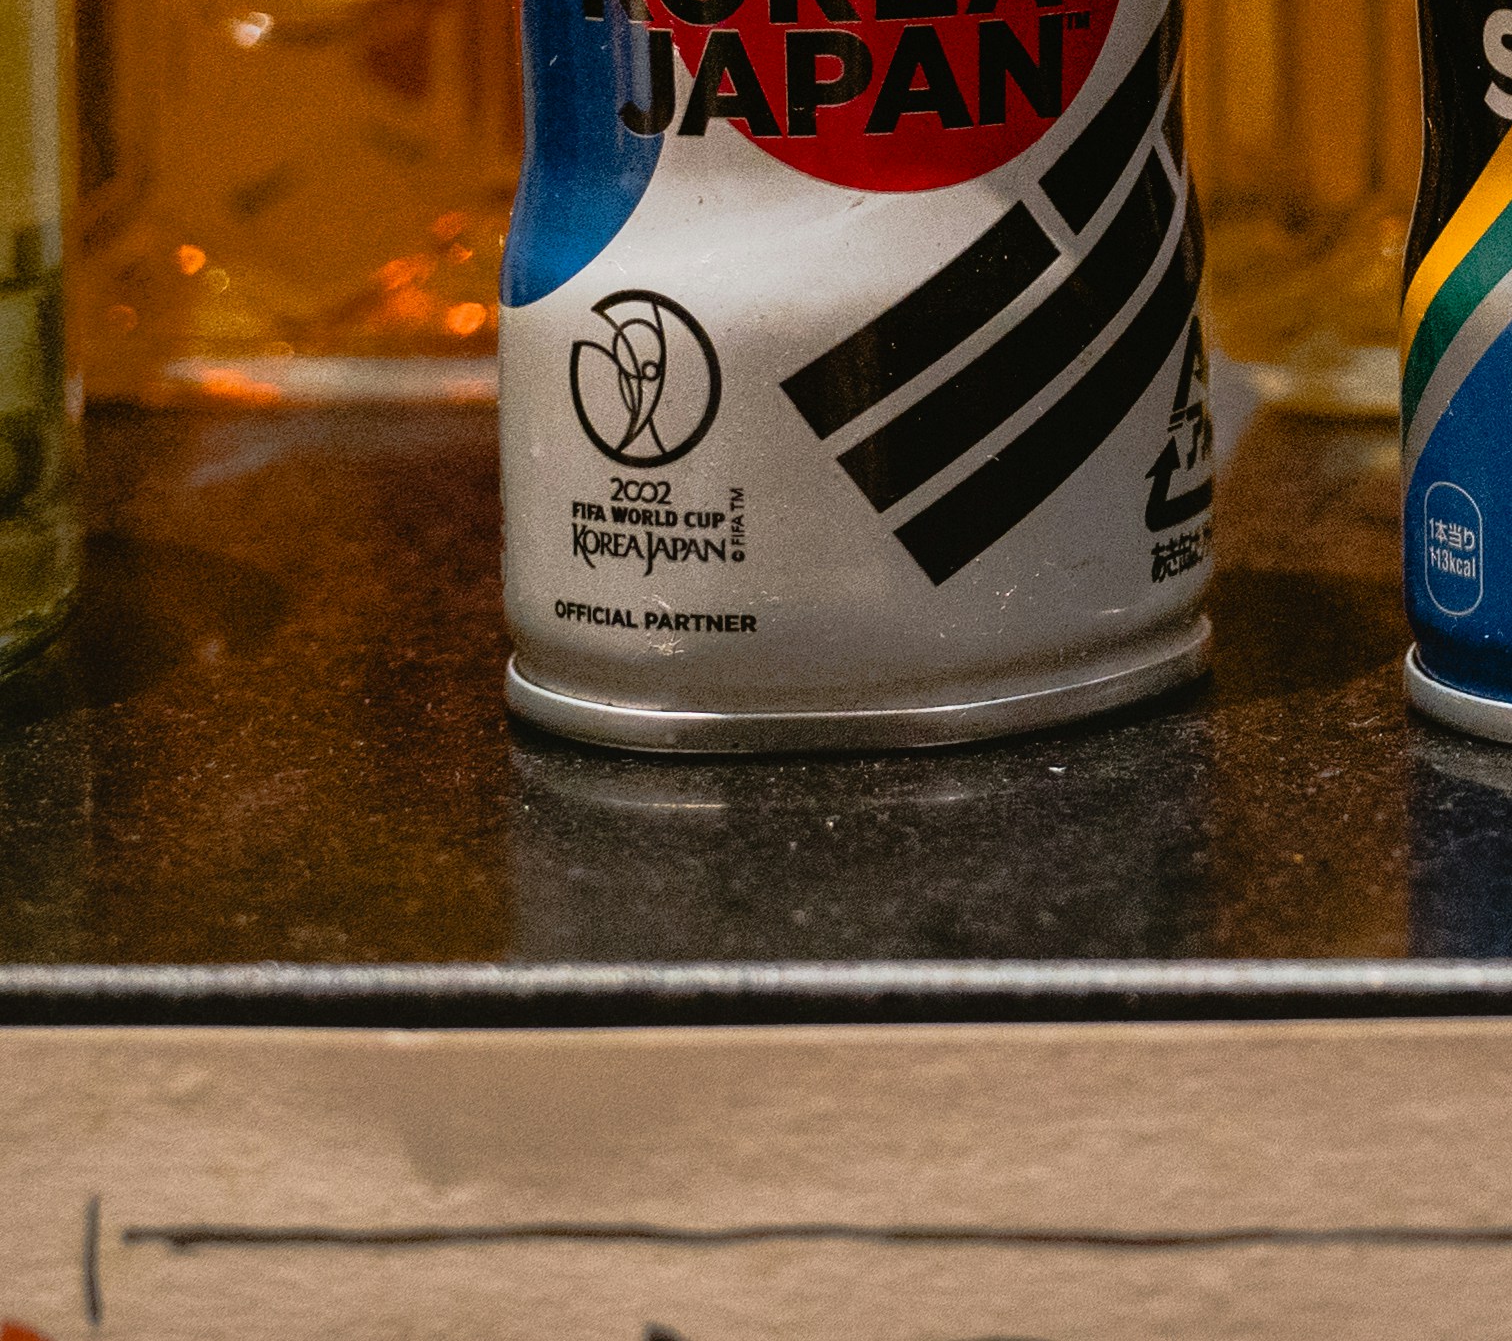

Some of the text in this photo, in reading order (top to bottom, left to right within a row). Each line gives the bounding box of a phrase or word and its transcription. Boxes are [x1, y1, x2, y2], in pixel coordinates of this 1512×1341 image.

[616, 17, 1064, 140] JAPAN
[609, 477, 673, 505] 2002
[571, 501, 726, 529] FIFA WORLD CUP
[571, 523, 727, 577] KOREA JAPAN
[1429, 517, 1476, 553] 1本当り
[1429, 545, 1477, 579] 113kcal
[554, 599, 758, 633] OFFICIAL PARTNER
